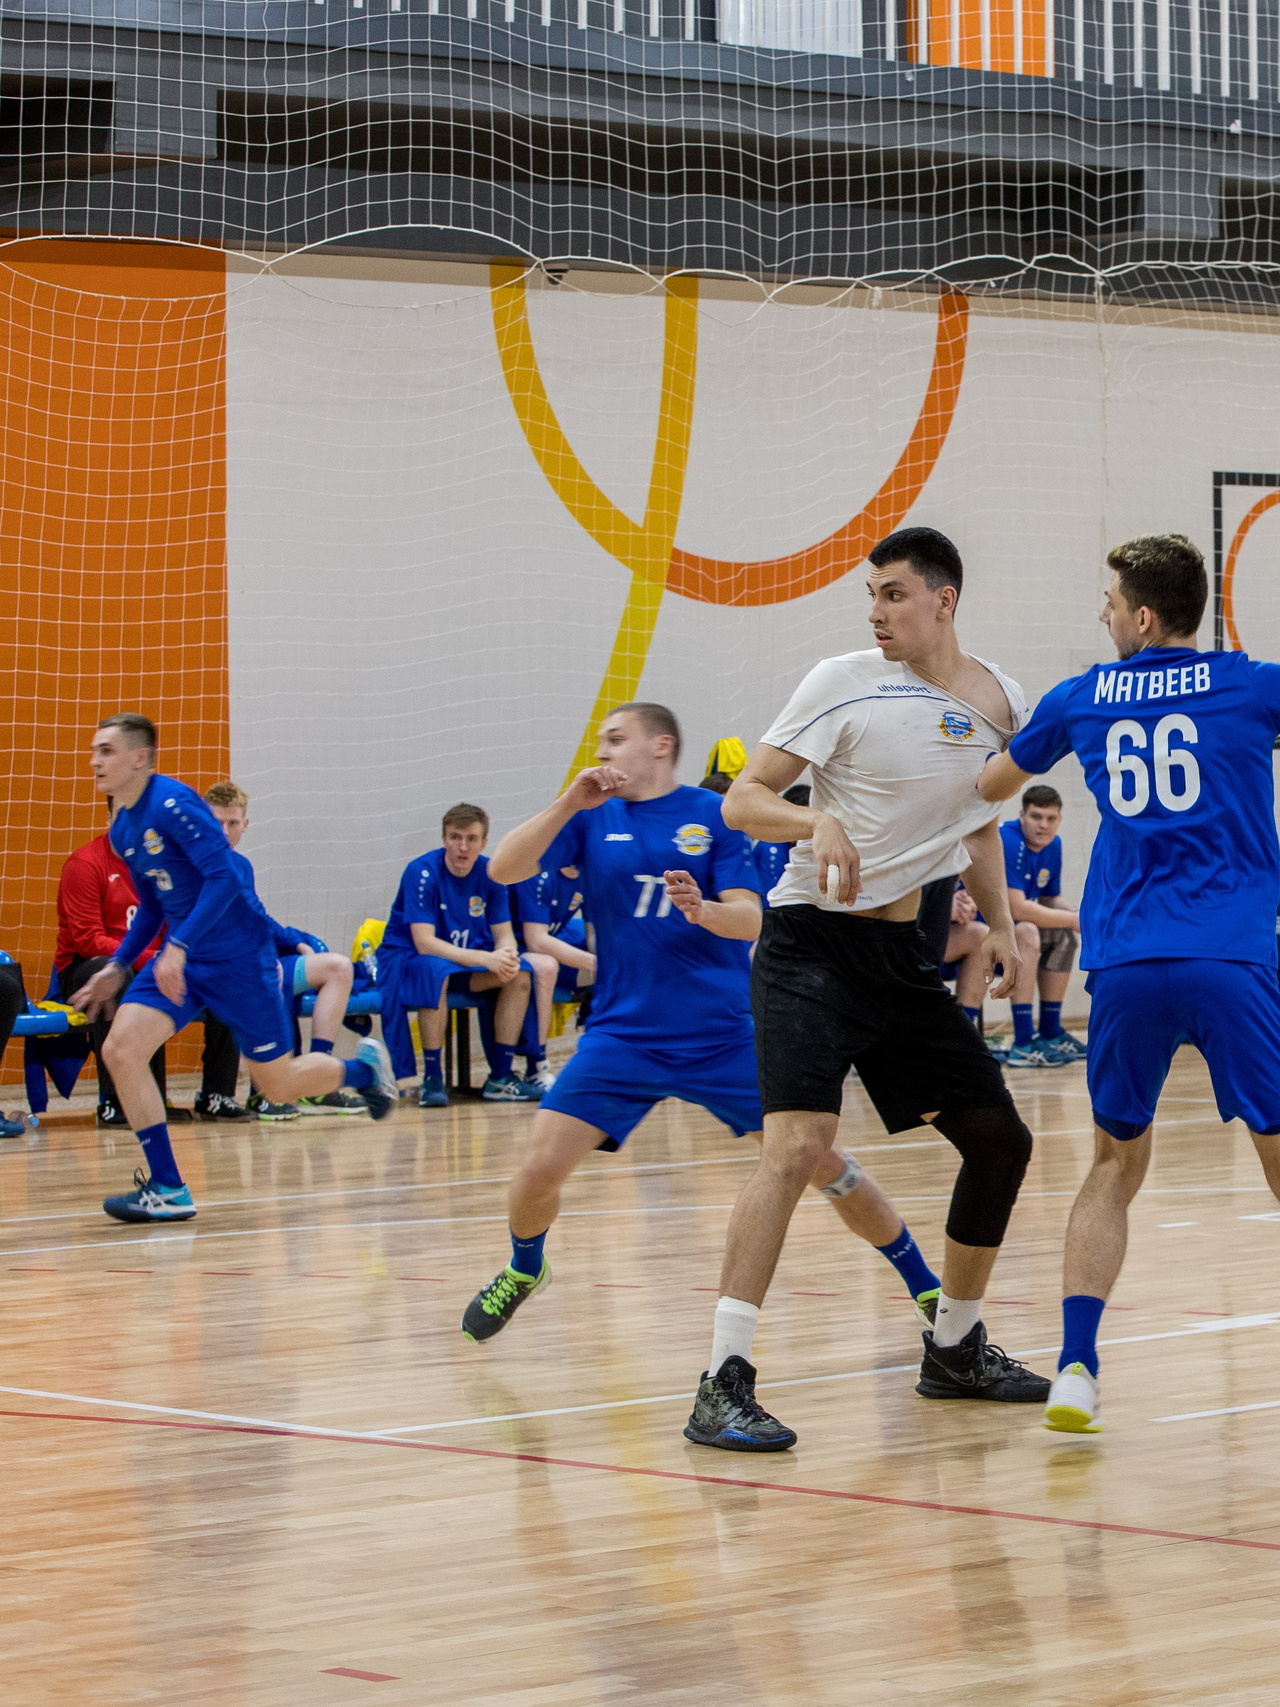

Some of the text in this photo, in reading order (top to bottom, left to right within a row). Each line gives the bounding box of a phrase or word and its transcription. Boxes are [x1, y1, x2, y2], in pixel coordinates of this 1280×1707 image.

[876, 684, 932, 695] uhlsport
[1094, 662, 1211, 704] МАТВЕЕВ
[1105, 712, 1201, 817] 66
[633, 875, 673, 918] 77
